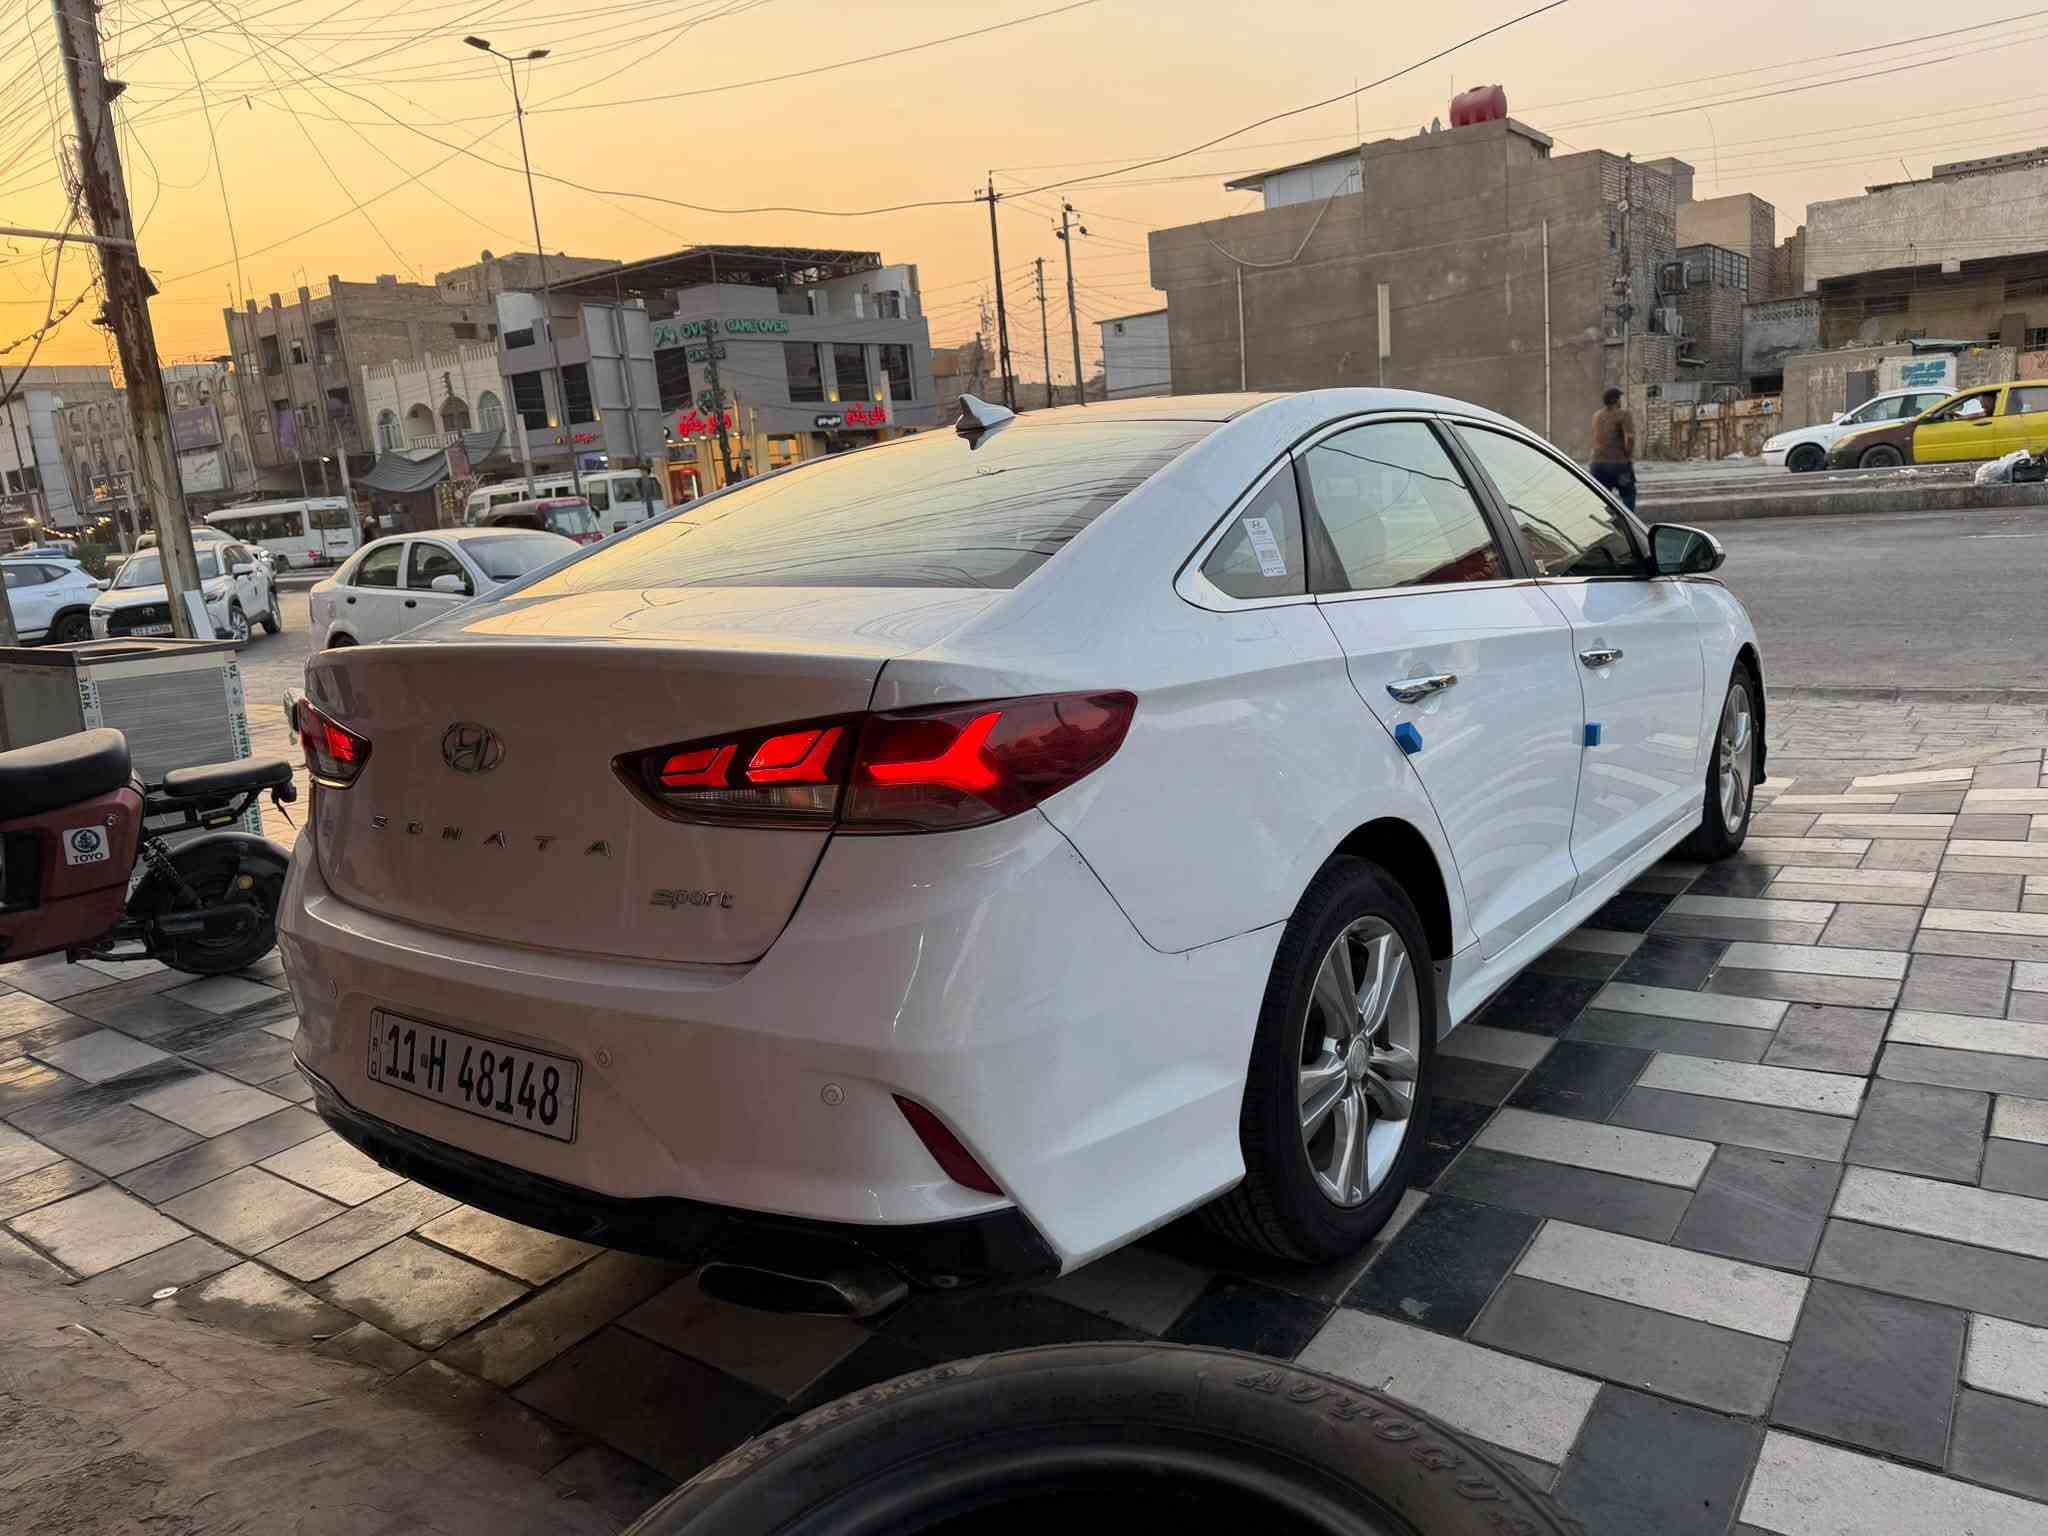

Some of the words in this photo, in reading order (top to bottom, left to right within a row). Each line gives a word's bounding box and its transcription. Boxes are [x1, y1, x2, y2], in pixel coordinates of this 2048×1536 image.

[758, 320, 789, 336] OVER
[371, 814, 612, 858] SONATA
[73, 852, 103, 863] TOYO
[385, 1024, 417, 1084] 11
[427, 1035, 448, 1093] H
[457, 1045, 560, 1126] 48148
